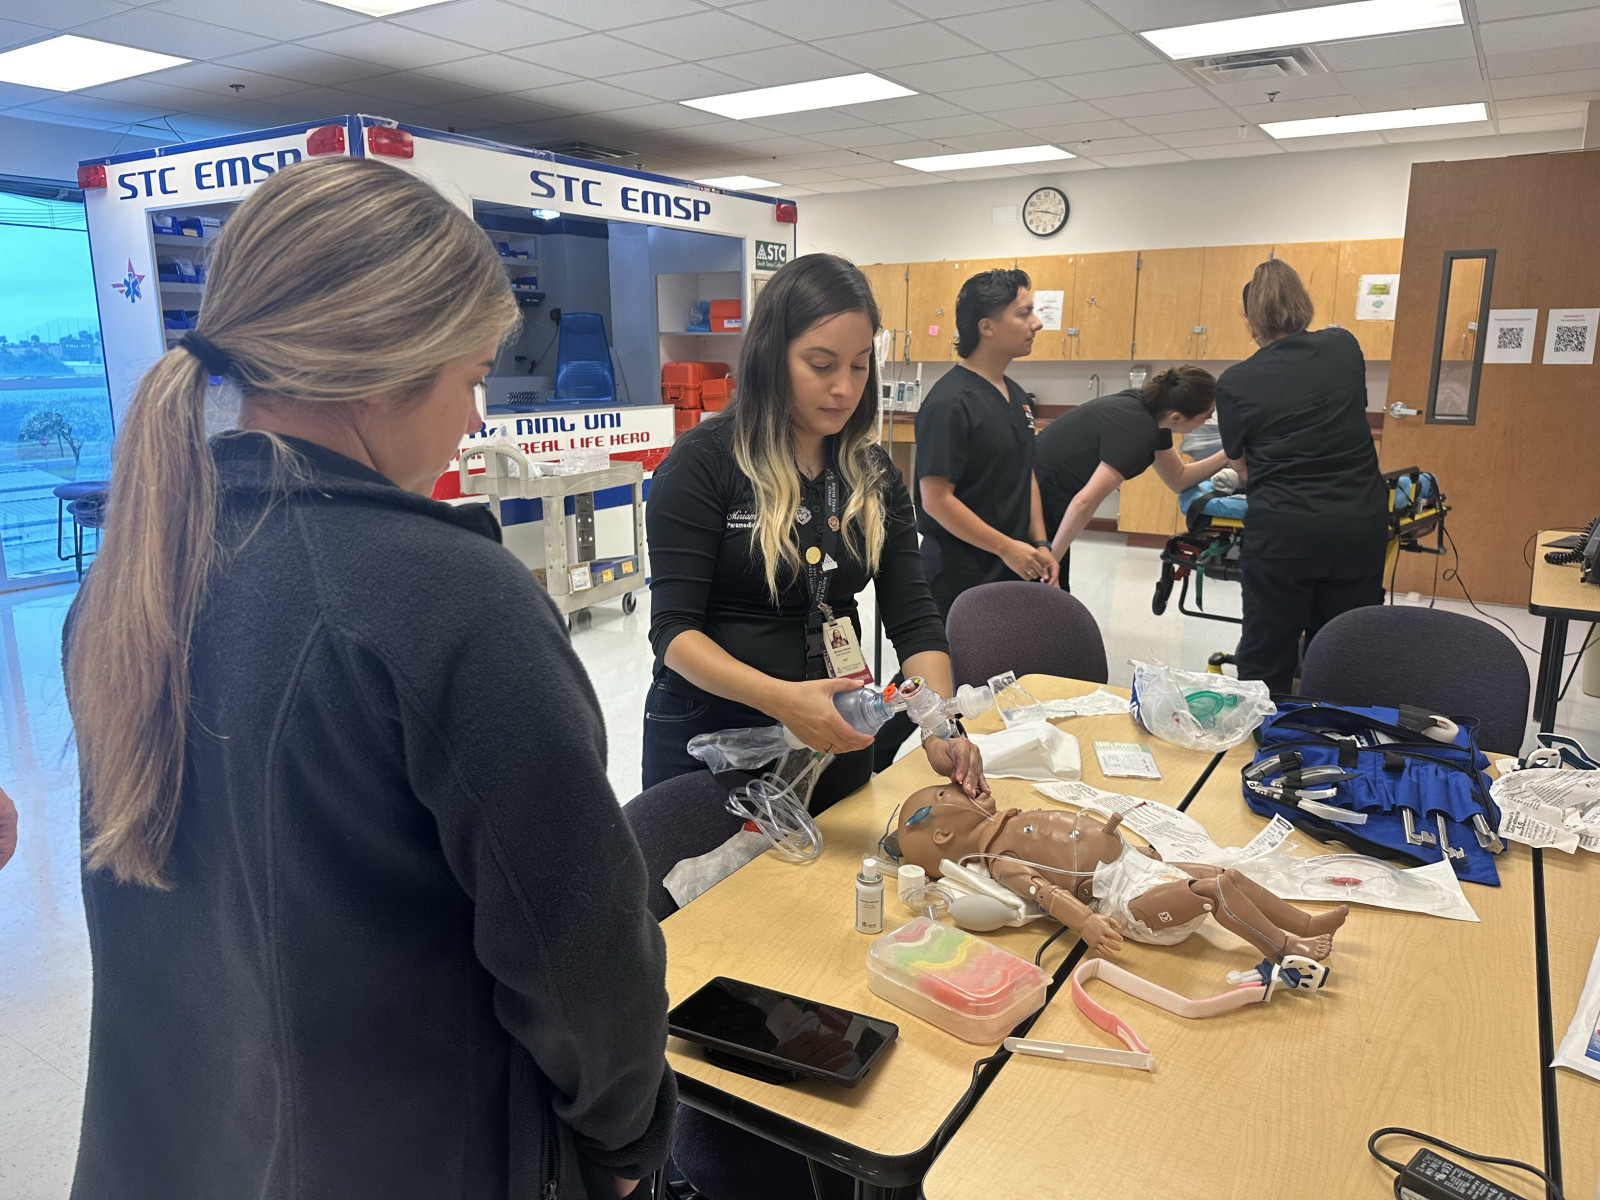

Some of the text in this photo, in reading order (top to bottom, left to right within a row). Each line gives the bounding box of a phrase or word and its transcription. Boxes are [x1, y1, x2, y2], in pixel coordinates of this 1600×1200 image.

[117, 148, 301, 200] STC EMSP
[530, 170, 711, 222] STC EMSP
[767, 244, 786, 262] STC
[517, 431, 650, 455] REAL LIFE HERO
[726, 508, 757, 521] Miriam
